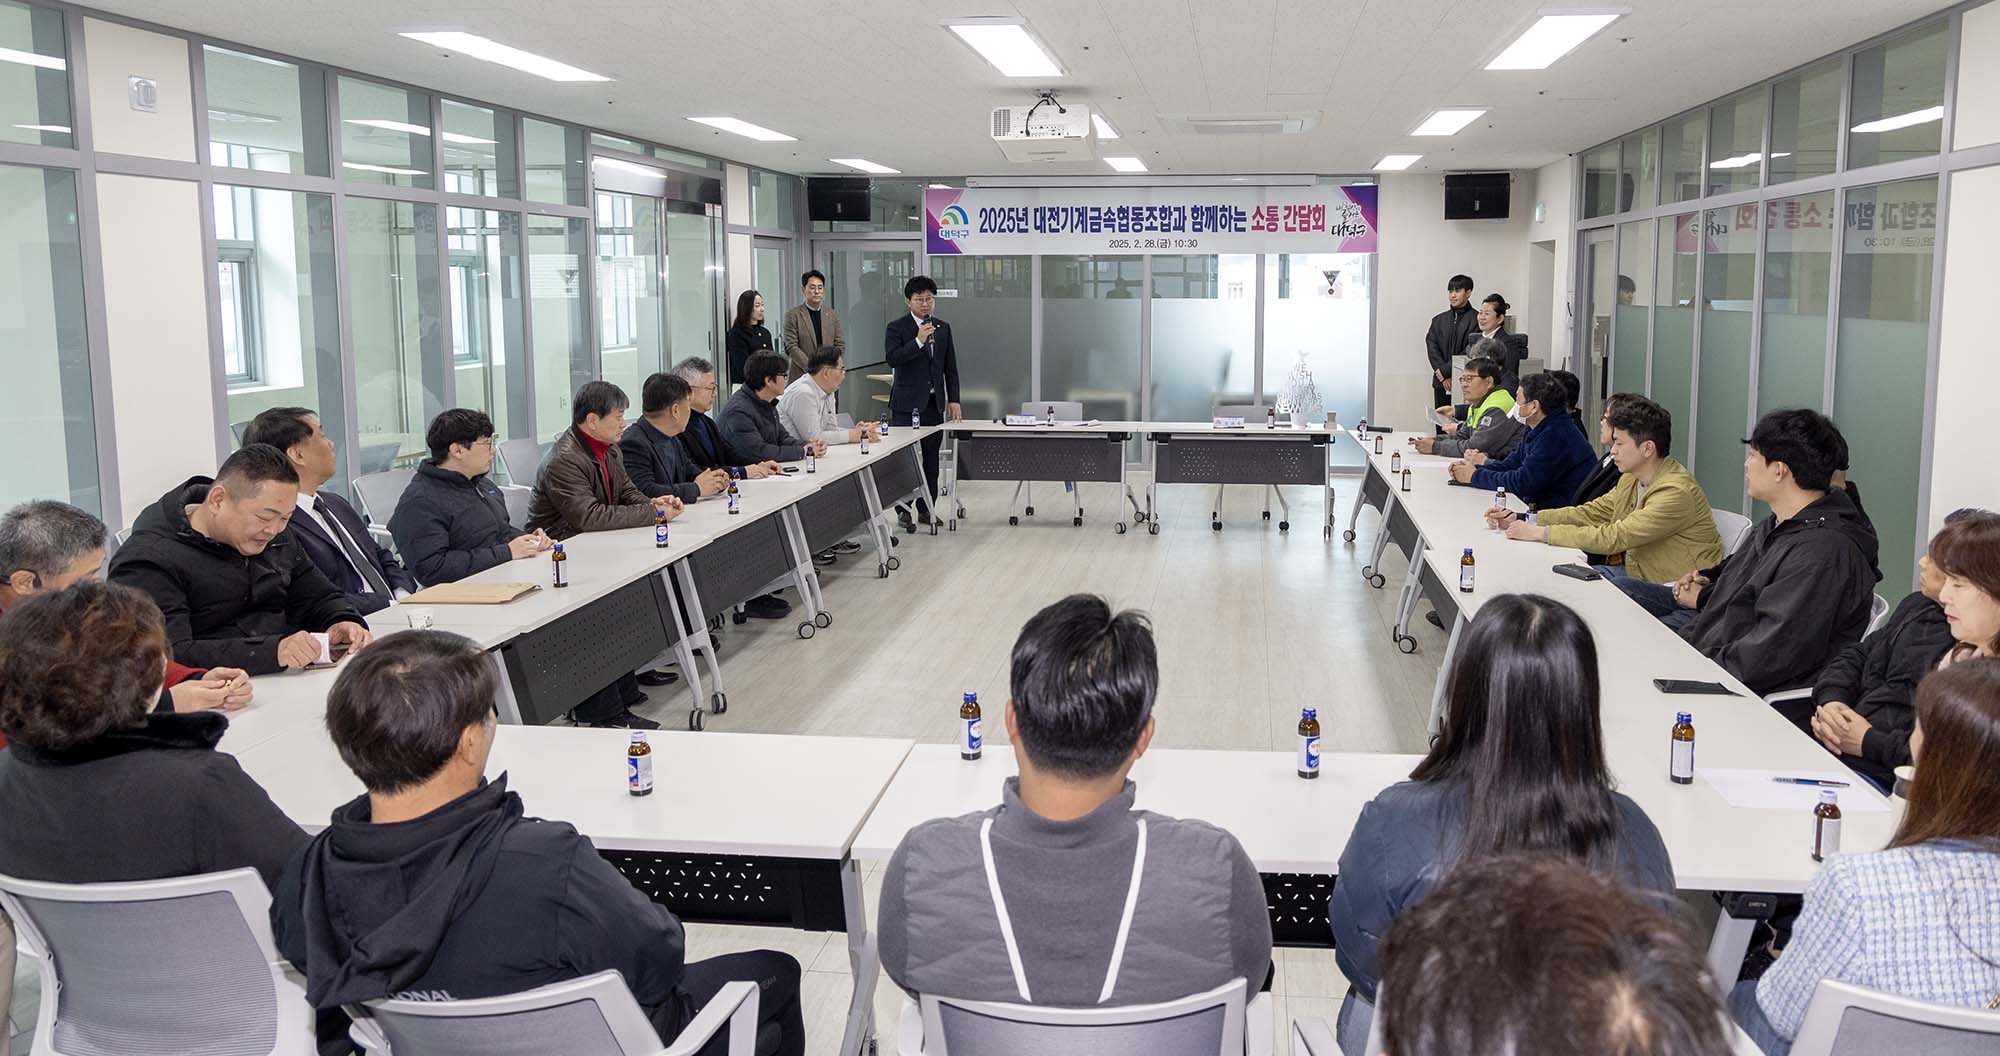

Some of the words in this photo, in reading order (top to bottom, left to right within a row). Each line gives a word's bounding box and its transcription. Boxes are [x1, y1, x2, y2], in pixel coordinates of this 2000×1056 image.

[979, 206, 1029, 233] 2025년
[1034, 205, 1187, 233] 대전기계금속협동조합과
[1190, 204, 1247, 232] 함께하는
[1251, 205, 1279, 232] 소통
[1283, 204, 1325, 232] 간담회
[940, 229, 969, 239] 대덕구
[1331, 223, 1366, 237] 대덕구
[1109, 240, 1131, 249] 2025.
[1134, 240, 1142, 249] 2.
[1144, 239, 1171, 249] 28.(금)
[1174, 239, 1198, 248] 10:30
